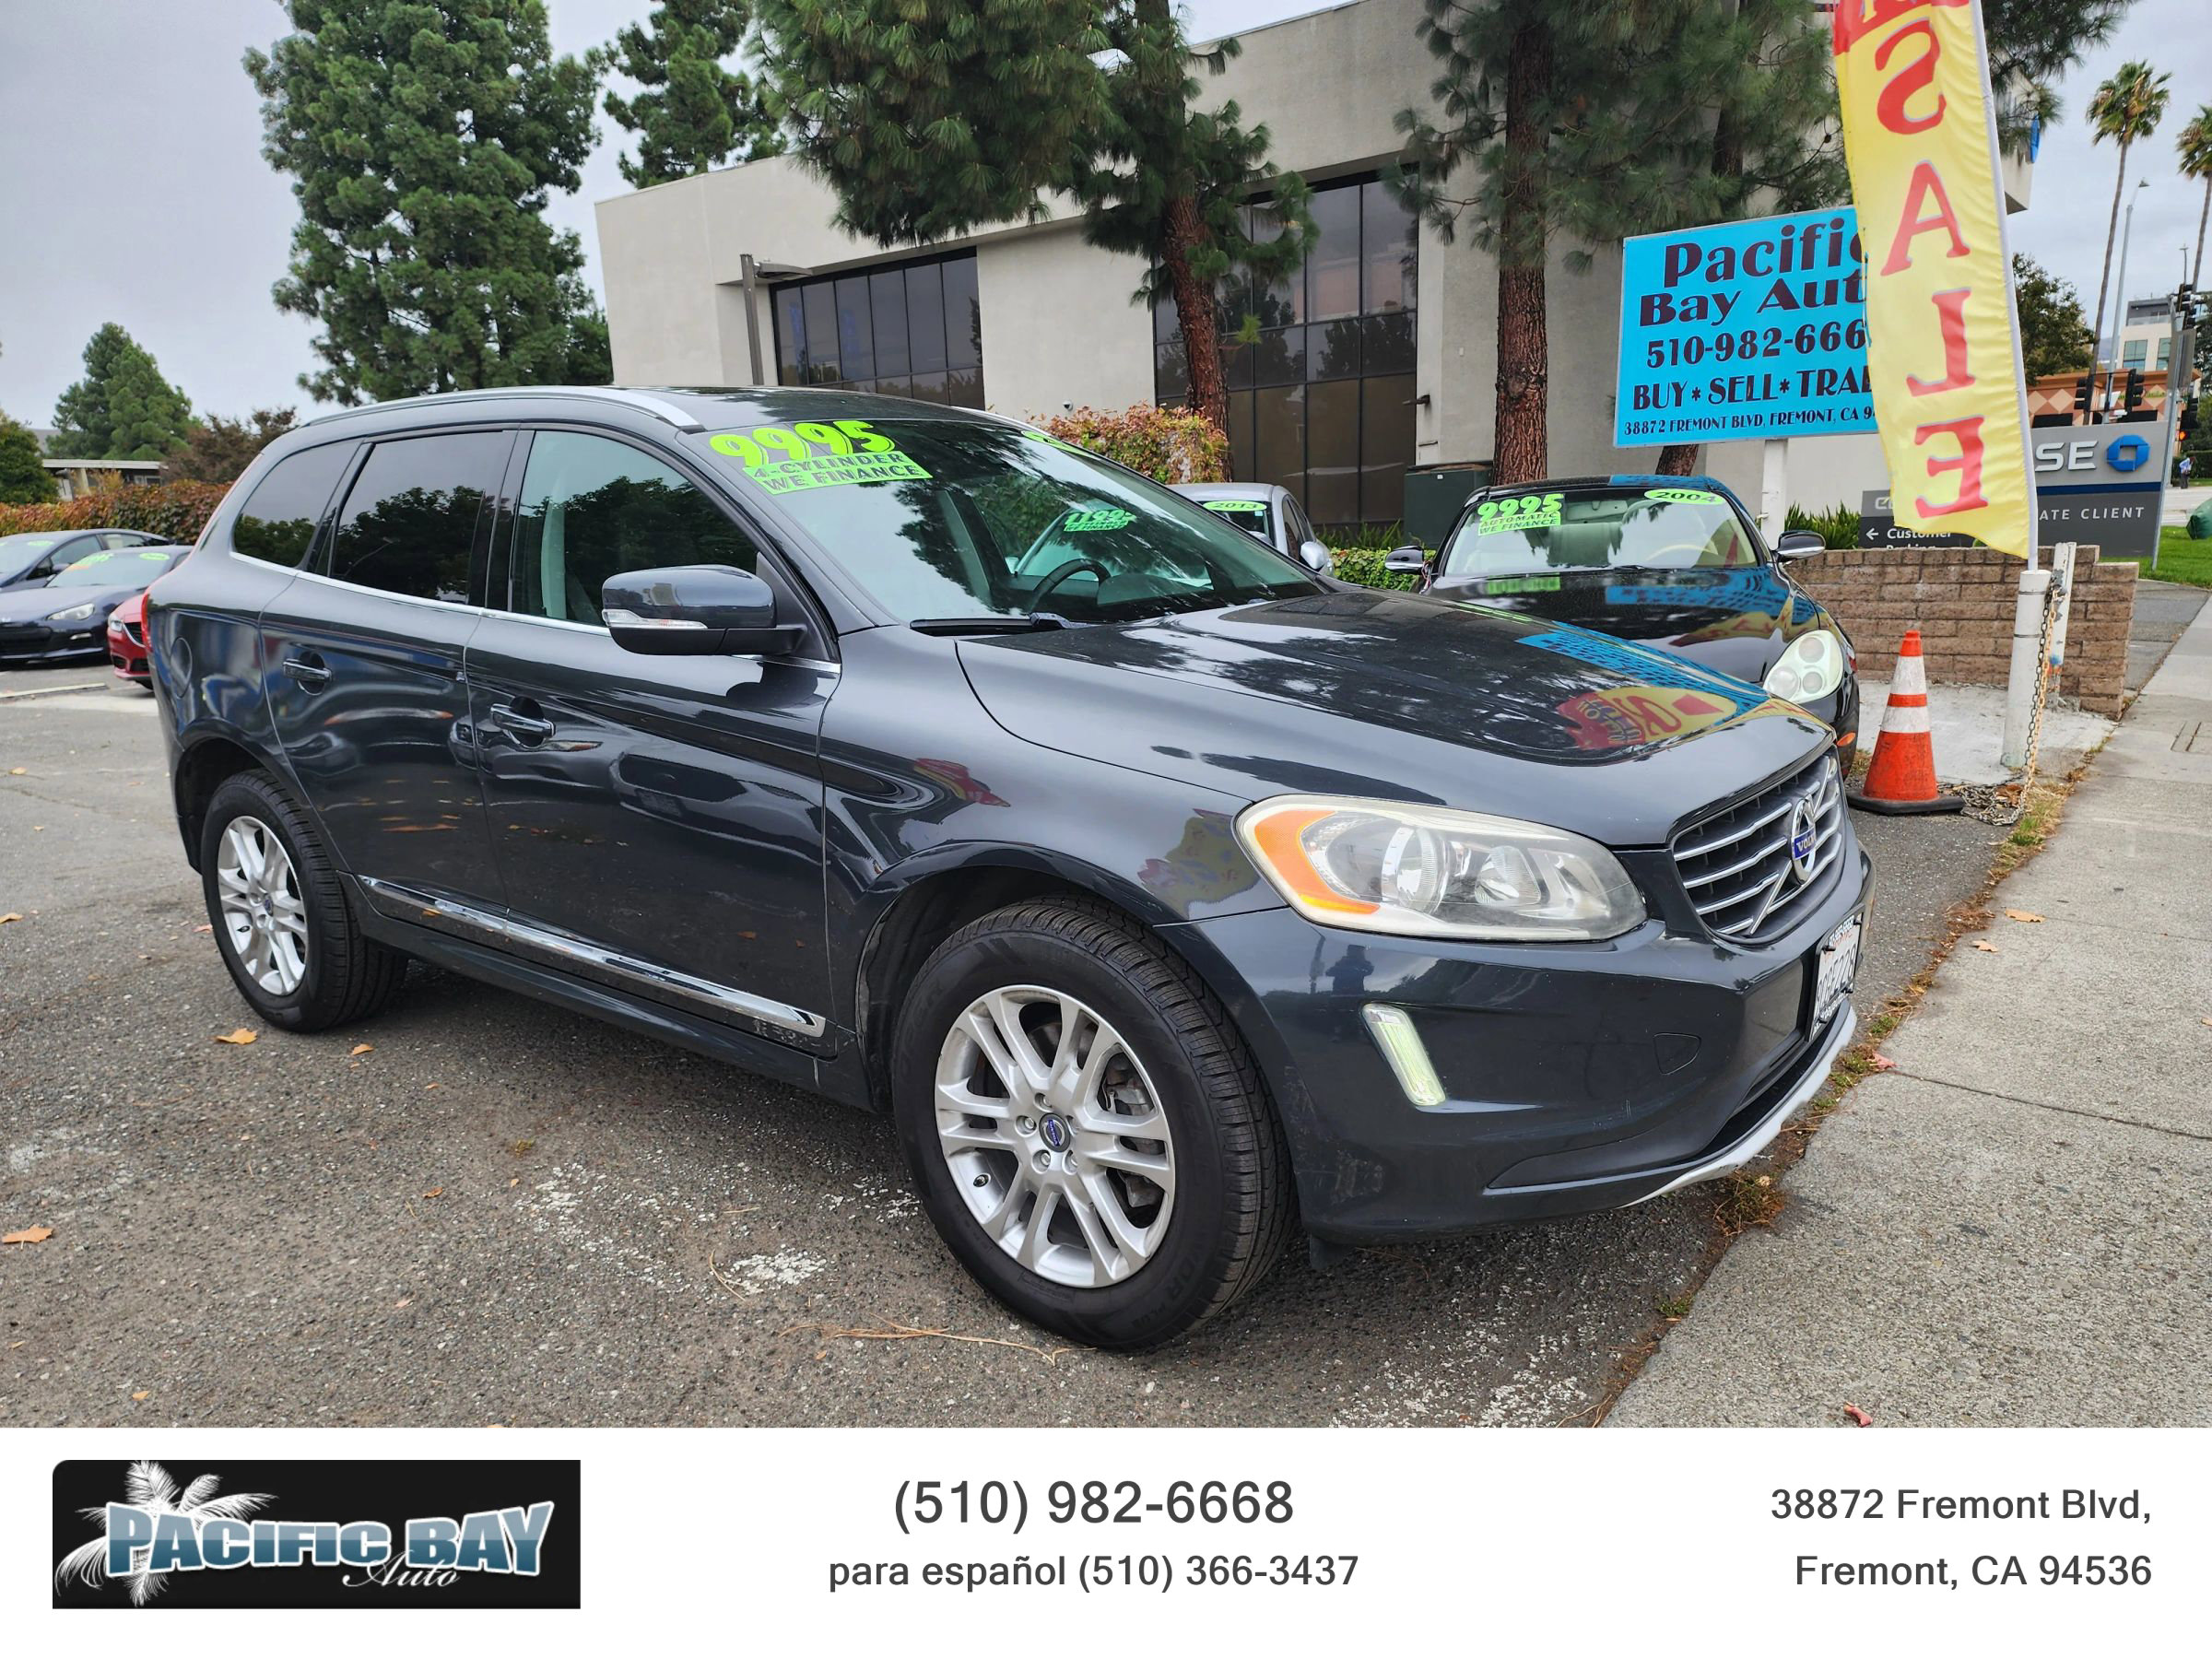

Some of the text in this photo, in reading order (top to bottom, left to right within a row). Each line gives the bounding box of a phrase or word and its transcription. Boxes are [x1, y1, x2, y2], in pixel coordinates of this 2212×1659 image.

[1640, 289, 1741, 326] Bay
[1633, 381, 1688, 410] BUY
[1708, 373, 1779, 405] SELL
[1624, 420, 1665, 436] 38872
[1669, 416, 1728, 432] FREMONT
[1732, 413, 1766, 429] BLVD,
[1770, 408, 1837, 426] FREMONT,
[1841, 406, 1859, 421] CA
[709, 420, 896, 467] 9995
[754, 453, 904, 478] 4-CYLINDER
[763, 465, 921, 491] WE FINANCE
[1477, 494, 1564, 523] 9995
[1653, 491, 1717, 503] 2004
[1481, 512, 1558, 527] AUTOMATIC
[2080, 506, 2145, 520] CLIENT
[1479, 518, 1558, 535] WE FINANCE
